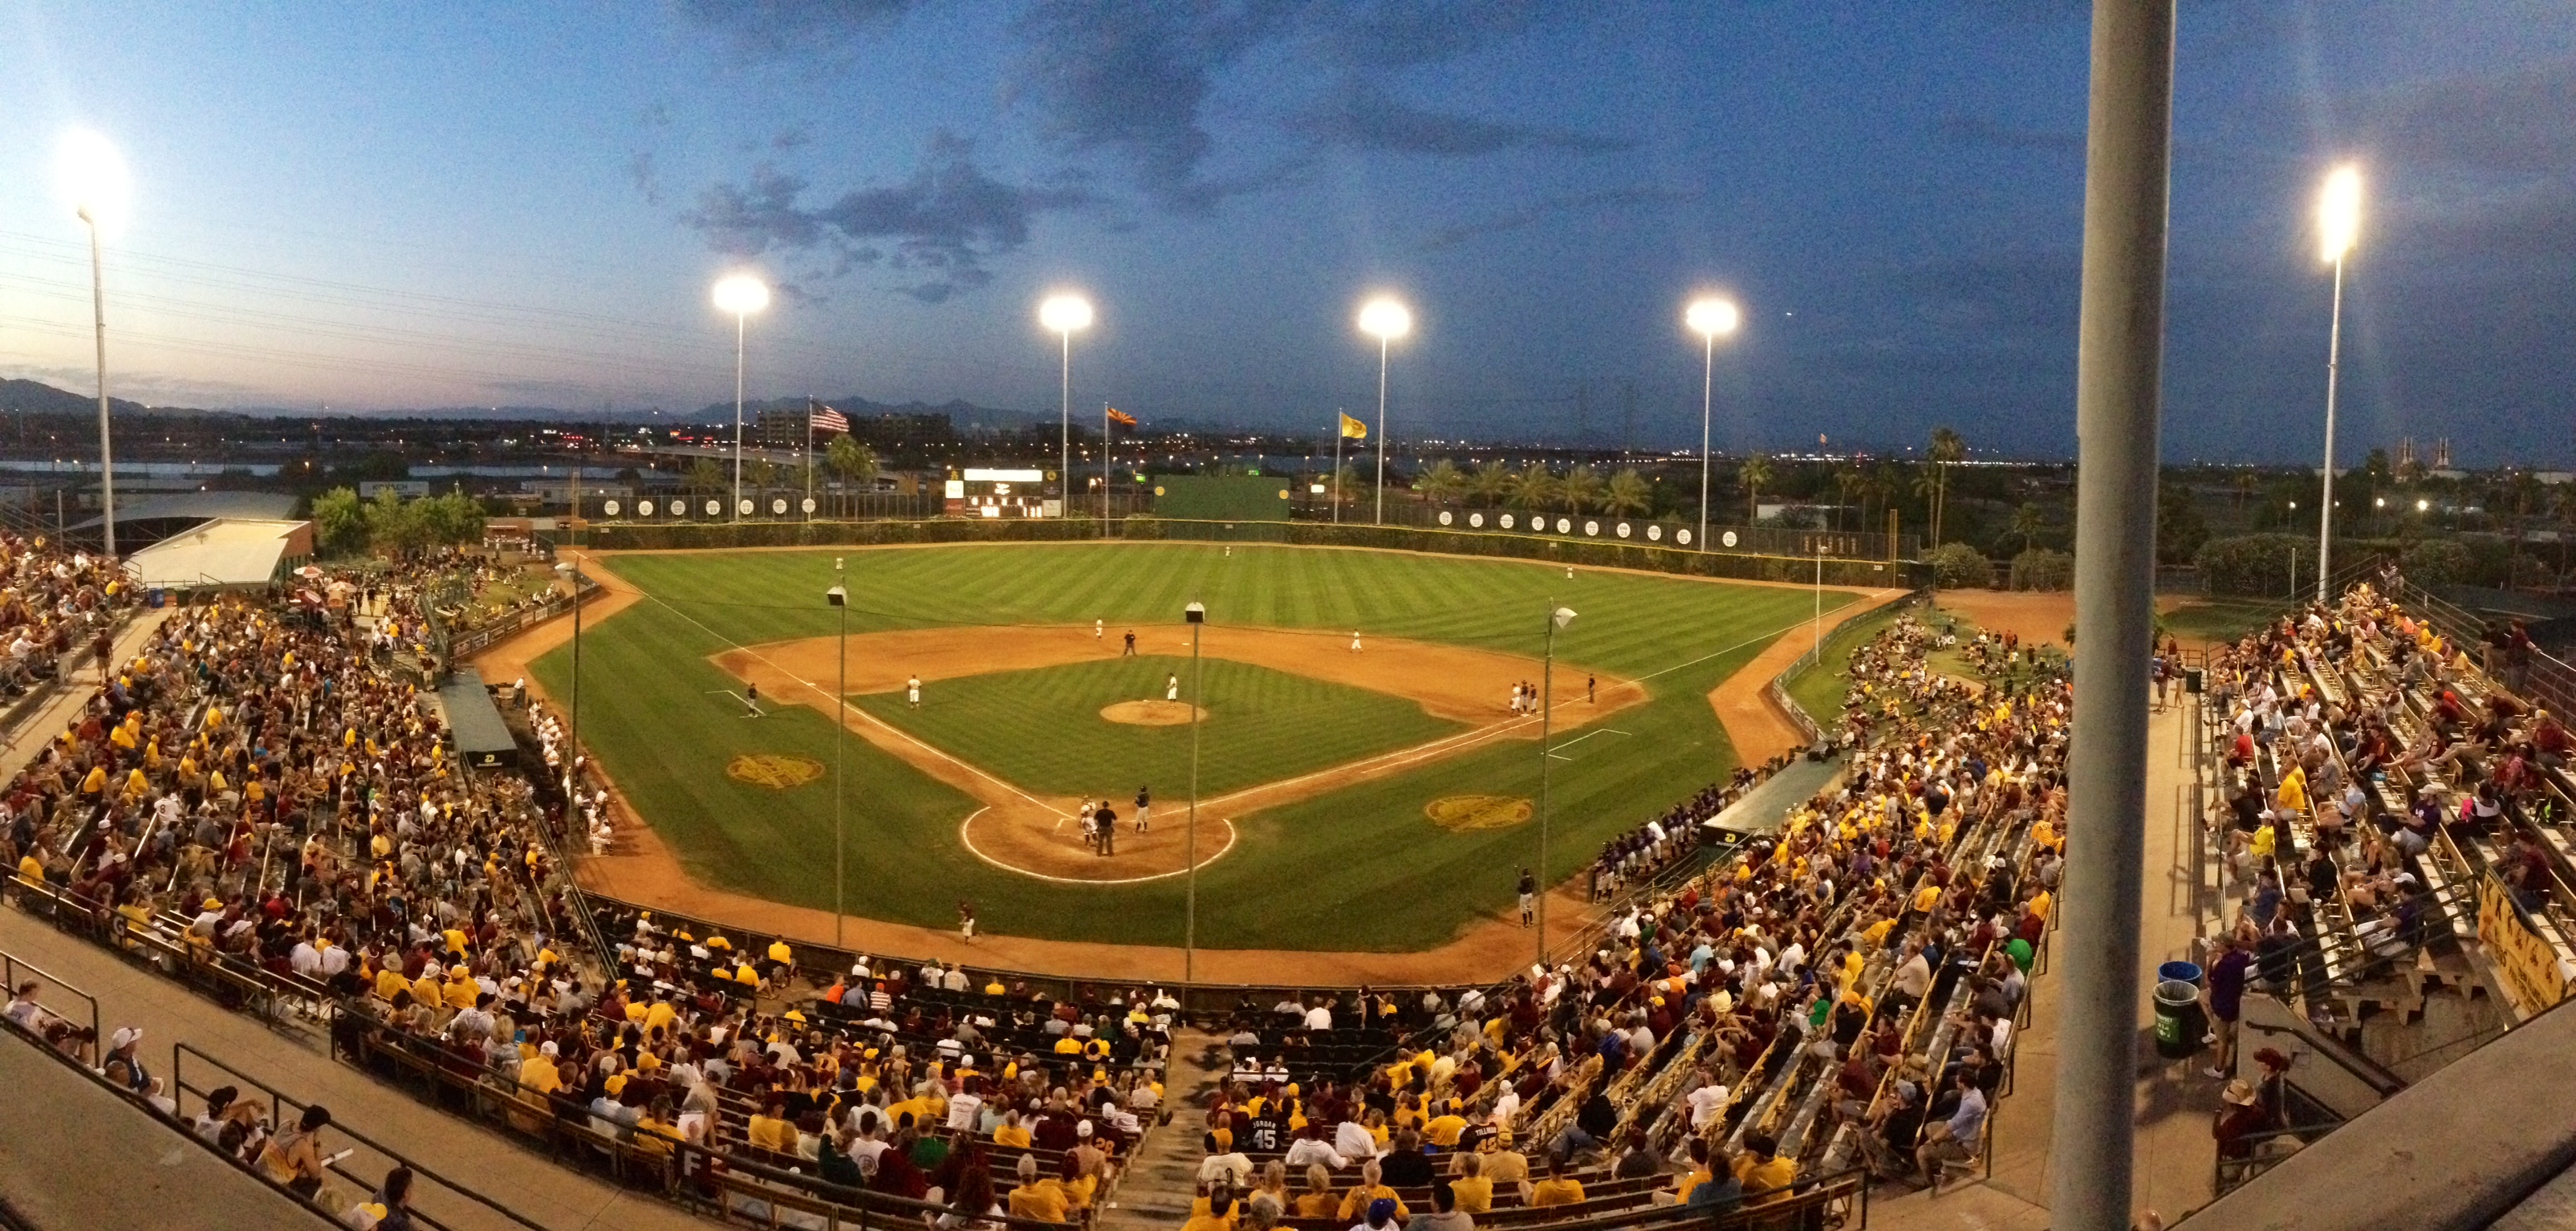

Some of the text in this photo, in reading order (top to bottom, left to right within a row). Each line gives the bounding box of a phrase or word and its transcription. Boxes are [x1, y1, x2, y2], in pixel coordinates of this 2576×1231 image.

[160, 804, 165, 814] 8
[113, 916, 125, 936] G
[1253, 1120, 1277, 1129] JORDAN
[1475, 1127, 1497, 1136] TILLMAN
[1095, 1137, 1115, 1158] 28
[1253, 1129, 1276, 1150] 45
[684, 1149, 701, 1176] F
